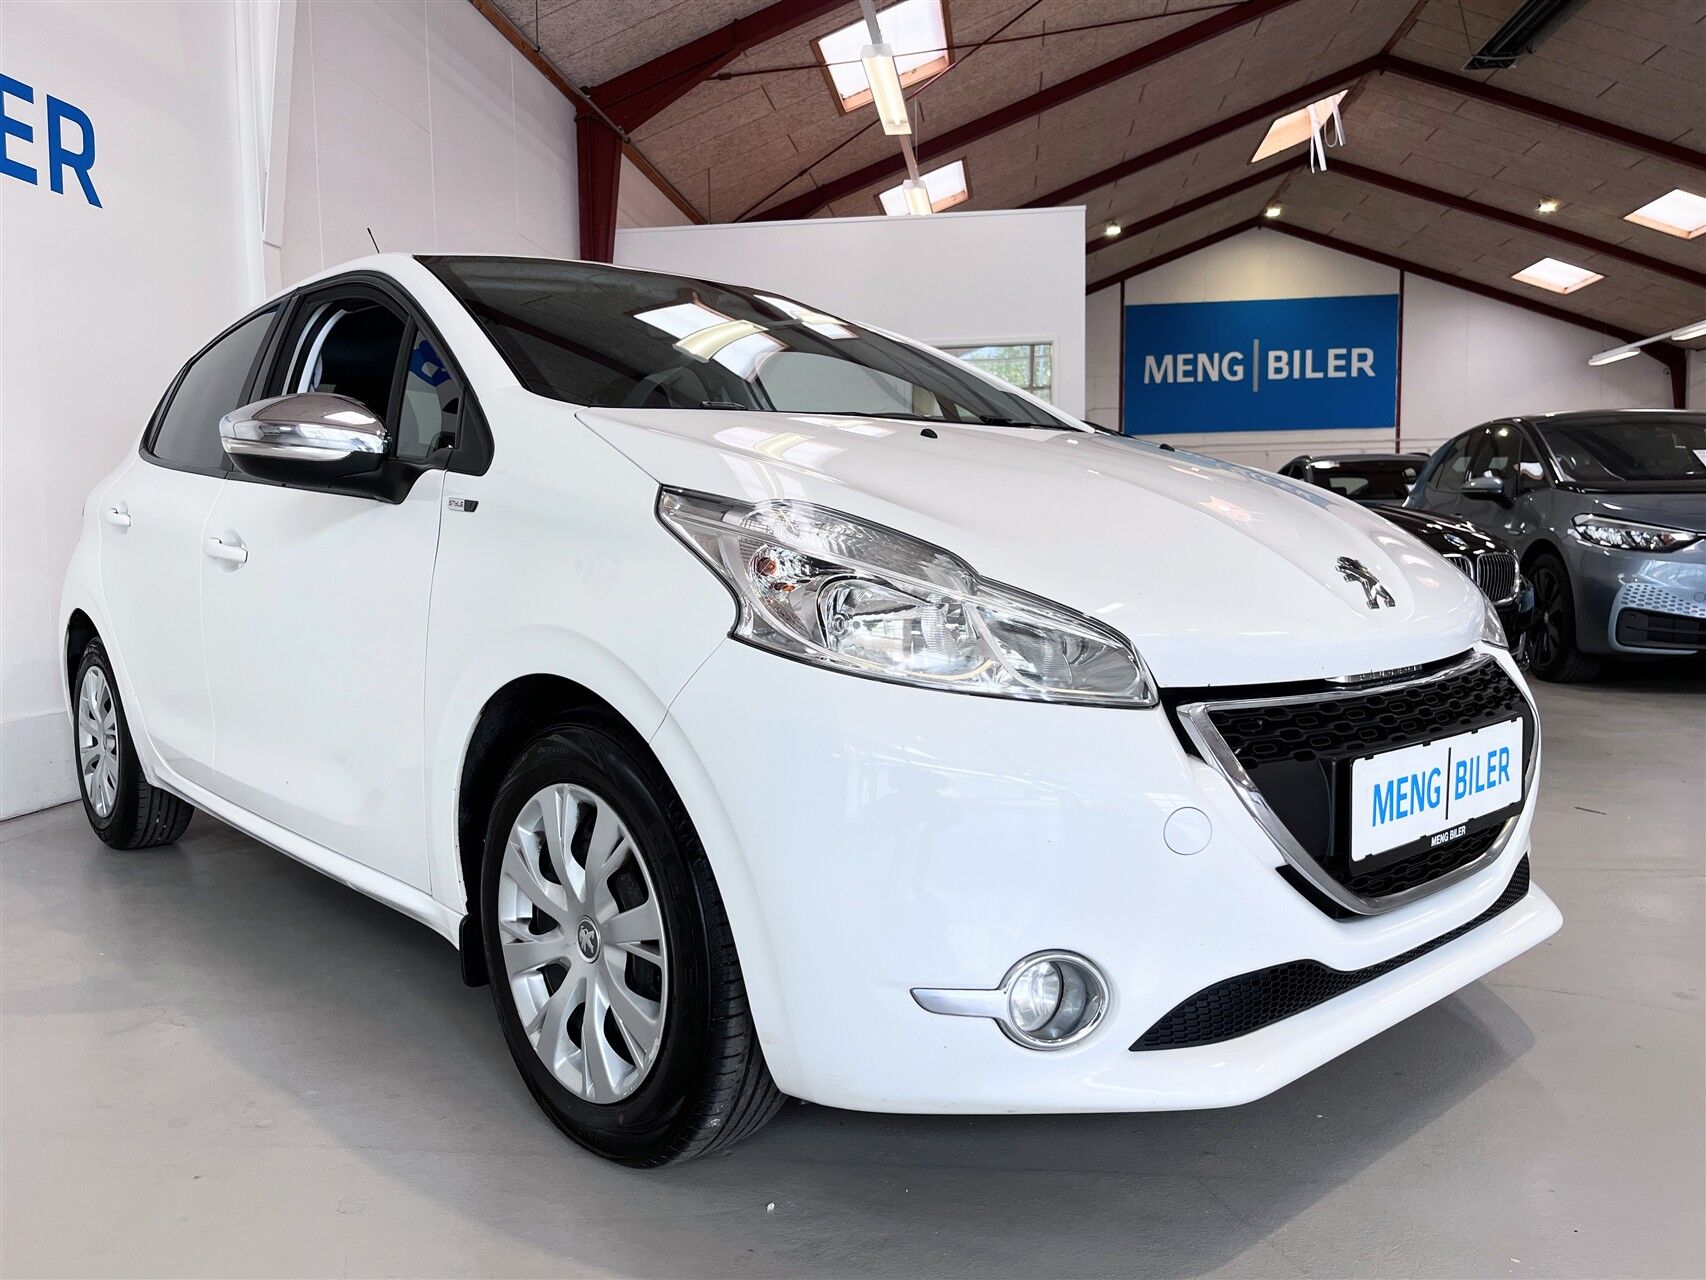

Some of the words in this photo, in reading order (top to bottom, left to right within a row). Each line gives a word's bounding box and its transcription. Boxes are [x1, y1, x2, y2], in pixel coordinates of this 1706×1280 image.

[1143, 351, 1245, 385] MENG
[1267, 347, 1376, 381] BILER
[1372, 767, 1442, 827] MENG
[1454, 746, 1510, 800] BILER
[1430, 831, 1449, 847] MENG
[1450, 825, 1466, 840] BILER
